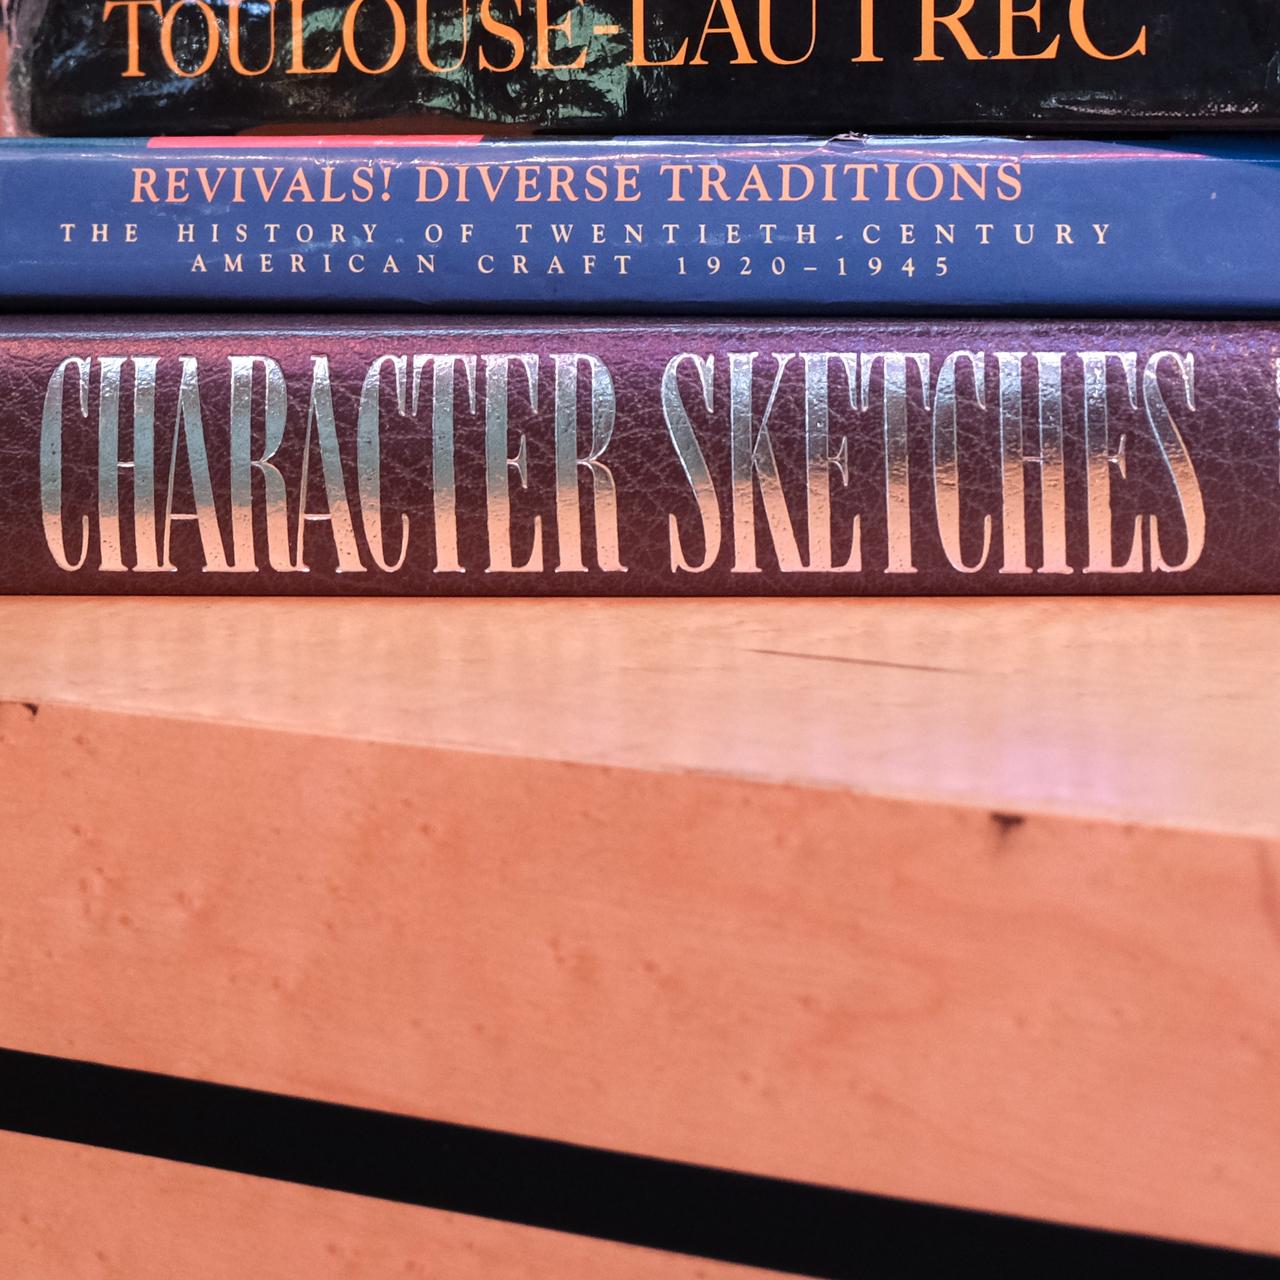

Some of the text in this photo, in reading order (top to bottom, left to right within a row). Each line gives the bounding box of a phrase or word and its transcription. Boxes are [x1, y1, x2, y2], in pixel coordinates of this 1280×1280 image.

[131, 162, 1022, 204] REVIVALS! DIVERSE TRADITIONS
[60, 222, 1112, 246] THE HISTORY OF TWENTIETH-CENTURY
[191, 253, 438, 275] AMERICAN
[477, 254, 632, 276] CRAFT
[40, 350, 1207, 575] CHARACTER SKETCHES
